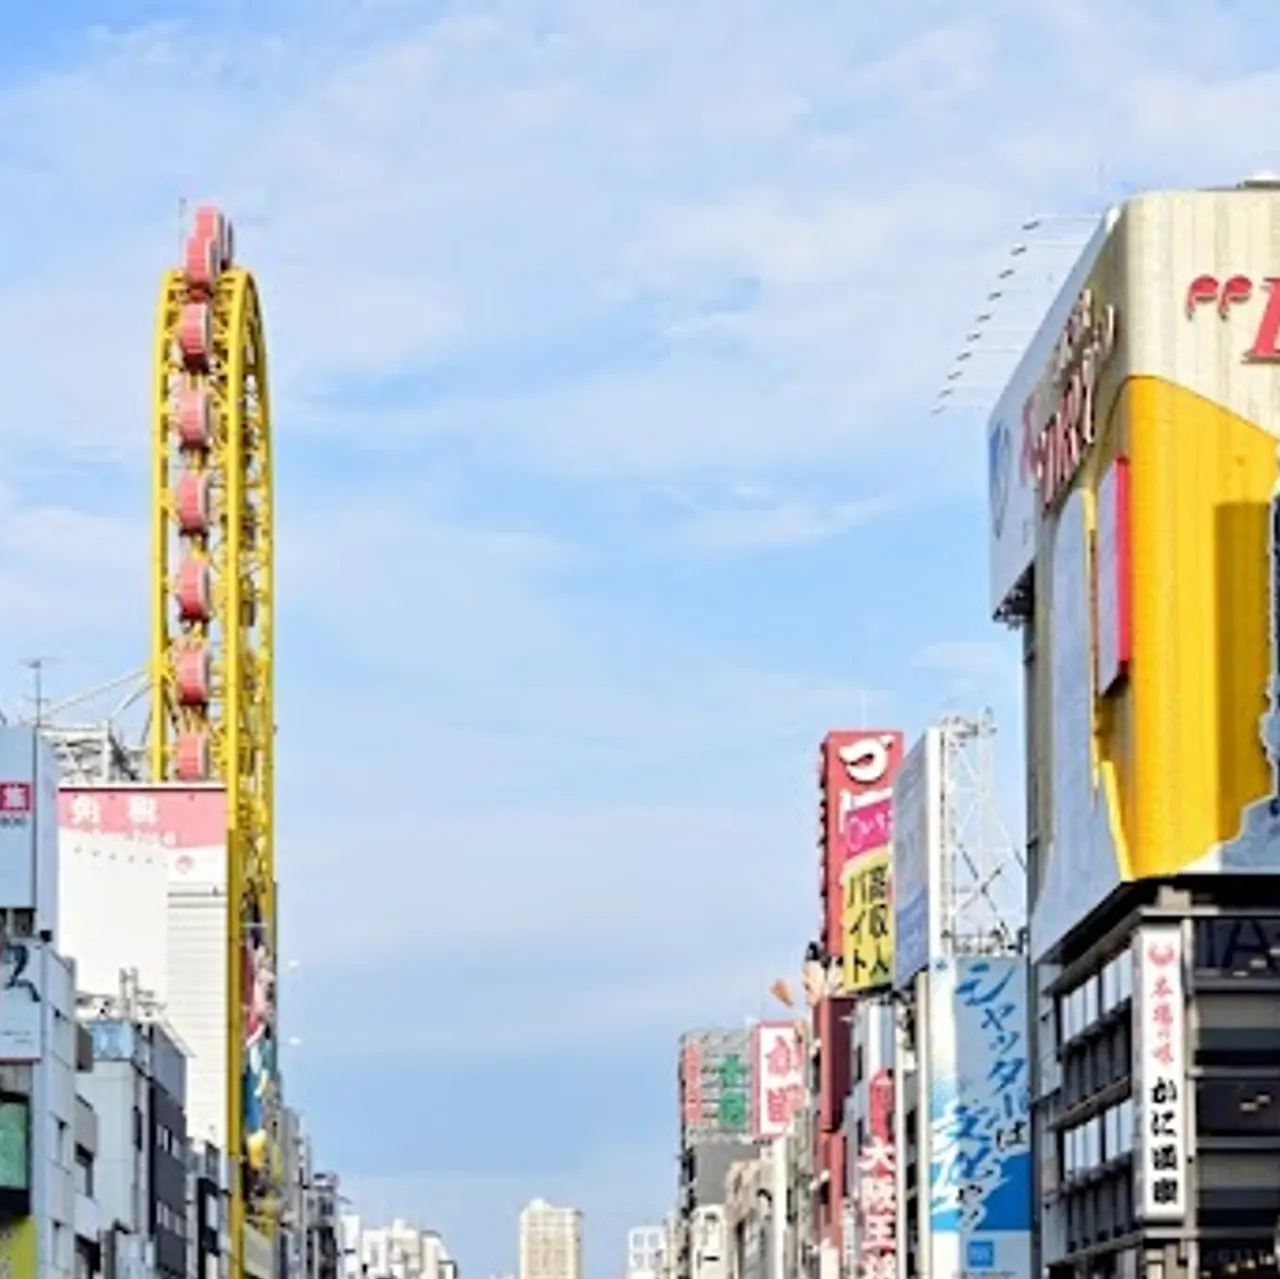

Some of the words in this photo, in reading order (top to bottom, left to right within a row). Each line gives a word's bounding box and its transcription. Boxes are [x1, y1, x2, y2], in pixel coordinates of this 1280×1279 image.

[848, 874, 867, 984] バイト
[868, 864, 890, 978] 高収入
[955, 963, 1027, 1153] シャッターは
